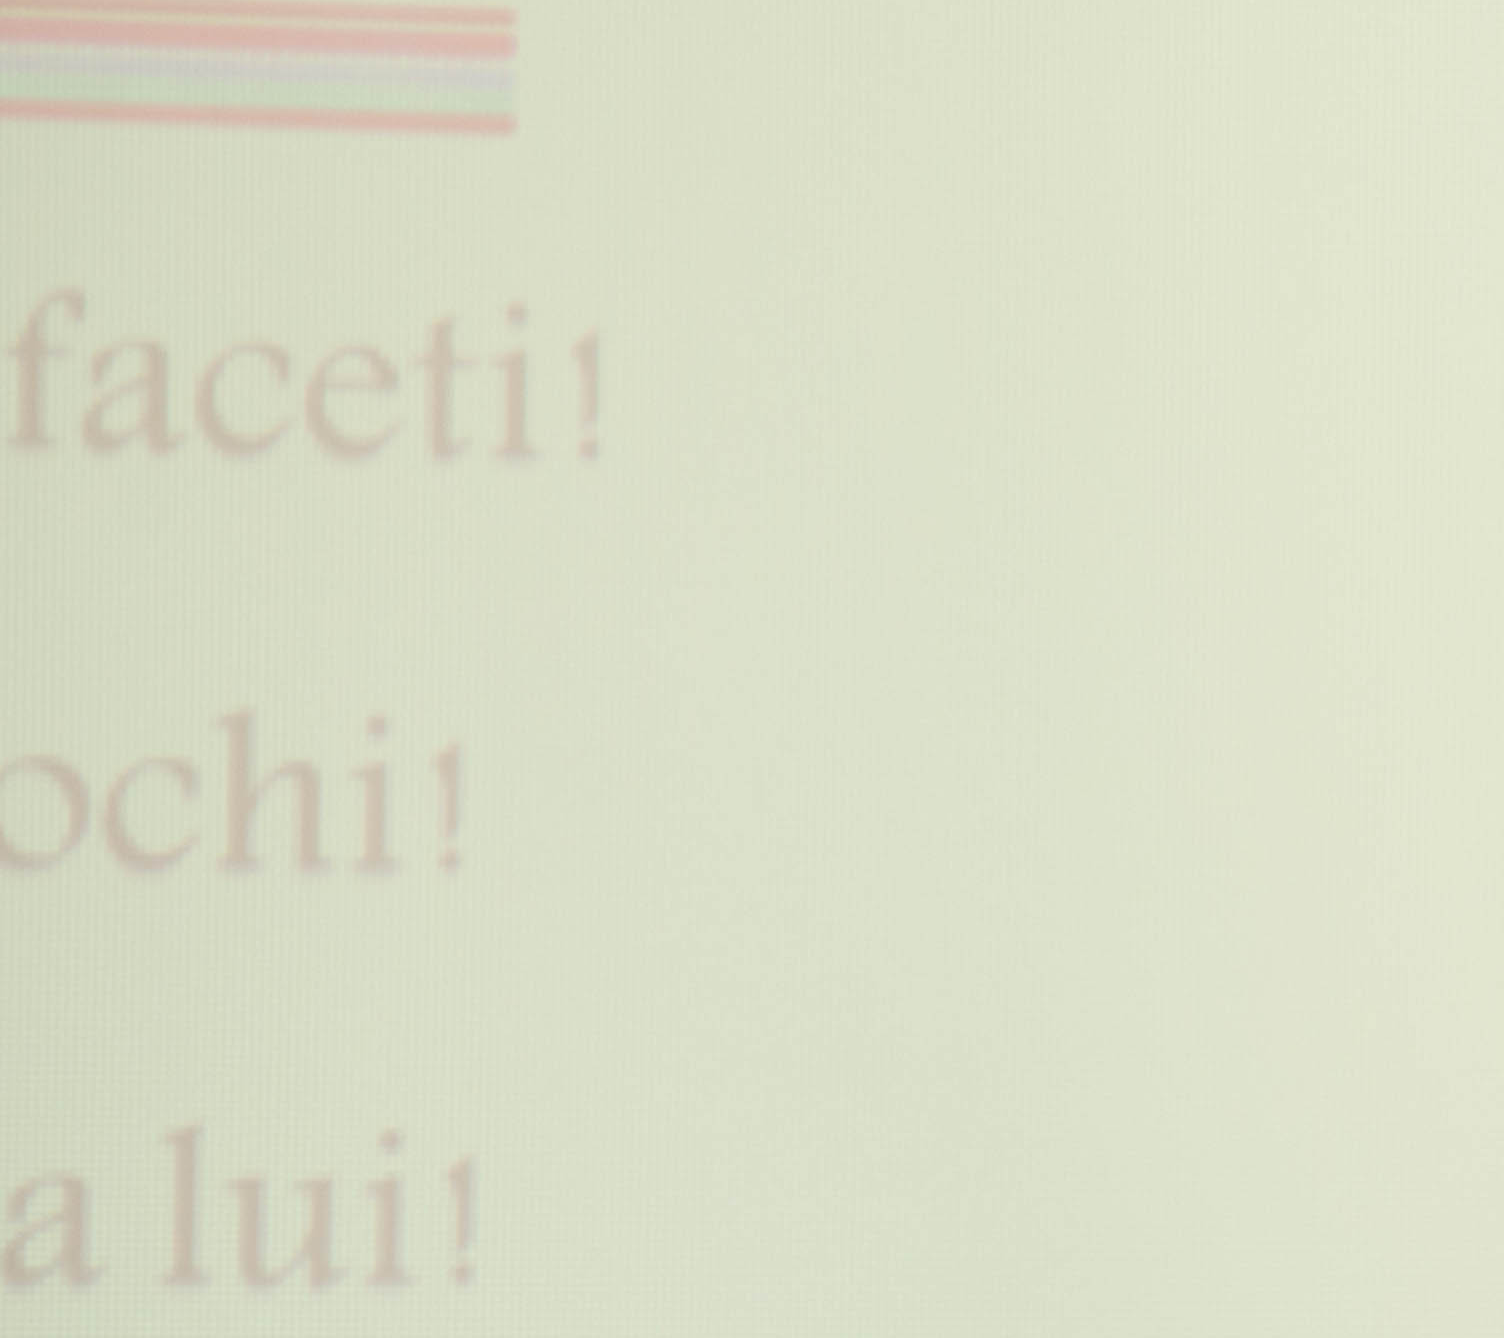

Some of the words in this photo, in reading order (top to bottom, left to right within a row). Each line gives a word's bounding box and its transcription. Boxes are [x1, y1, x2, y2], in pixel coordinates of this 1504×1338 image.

[6, 285, 602, 462] faceti!
[0, 706, 464, 874] ochi!
[0, 1169, 102, 1293] a
[158, 1120, 479, 1293] lui!
